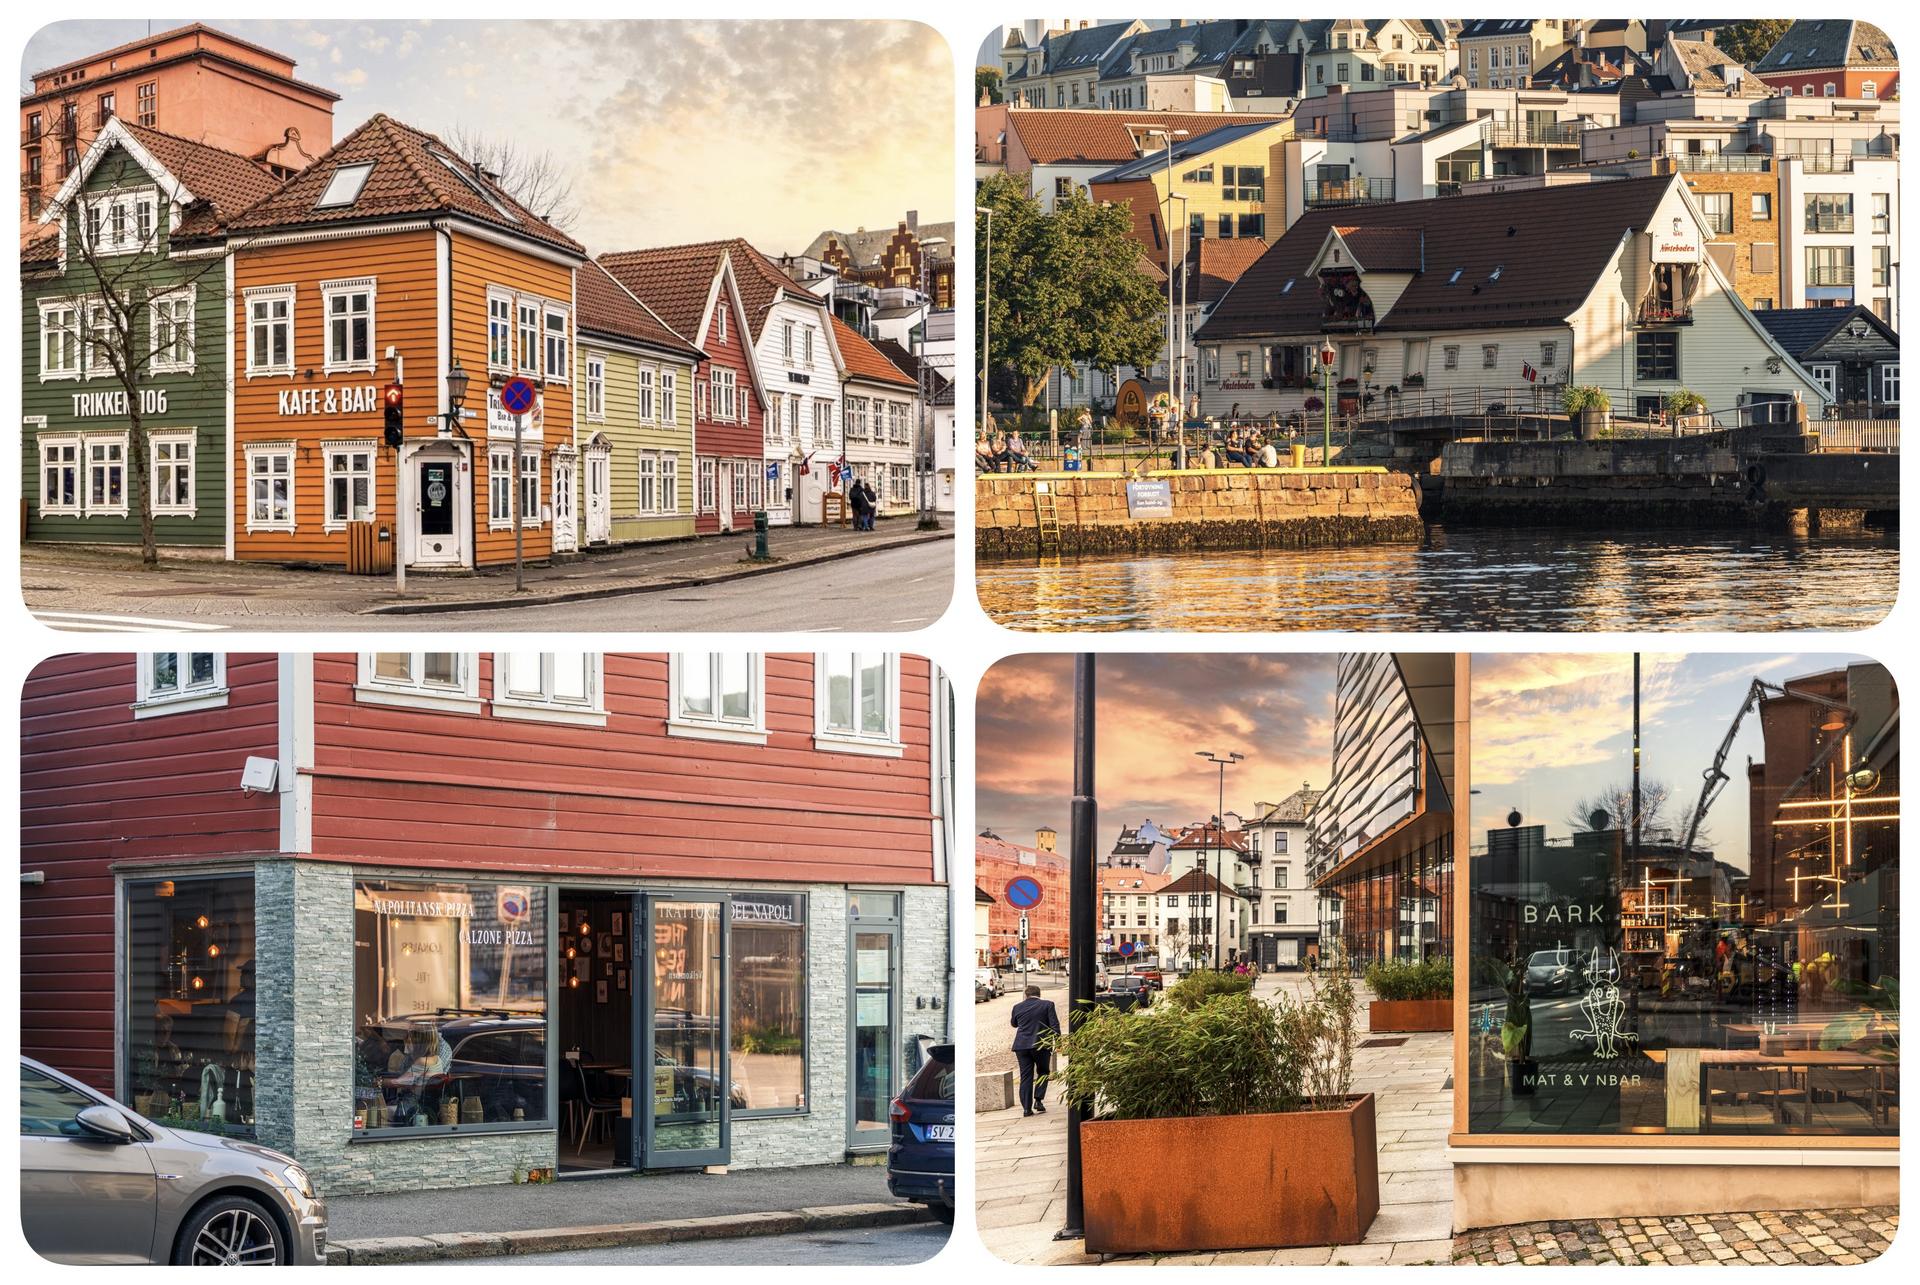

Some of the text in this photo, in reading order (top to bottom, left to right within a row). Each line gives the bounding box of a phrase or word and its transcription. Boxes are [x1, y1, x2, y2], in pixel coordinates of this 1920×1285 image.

[71, 389, 168, 417] TRIKKEN 106
[278, 385, 377, 416] KAFE & BAR
[373, 899, 474, 917] NAPOLITANSK PIZZA
[753, 904, 792, 920] NAPOLI
[1524, 904, 1604, 923] BARK
[458, 929, 533, 945] CALZONE PIZZA
[1523, 1074, 1557, 1087] MAT
[1563, 1073, 1573, 1086] &
[932, 1126, 945, 1138] SV
